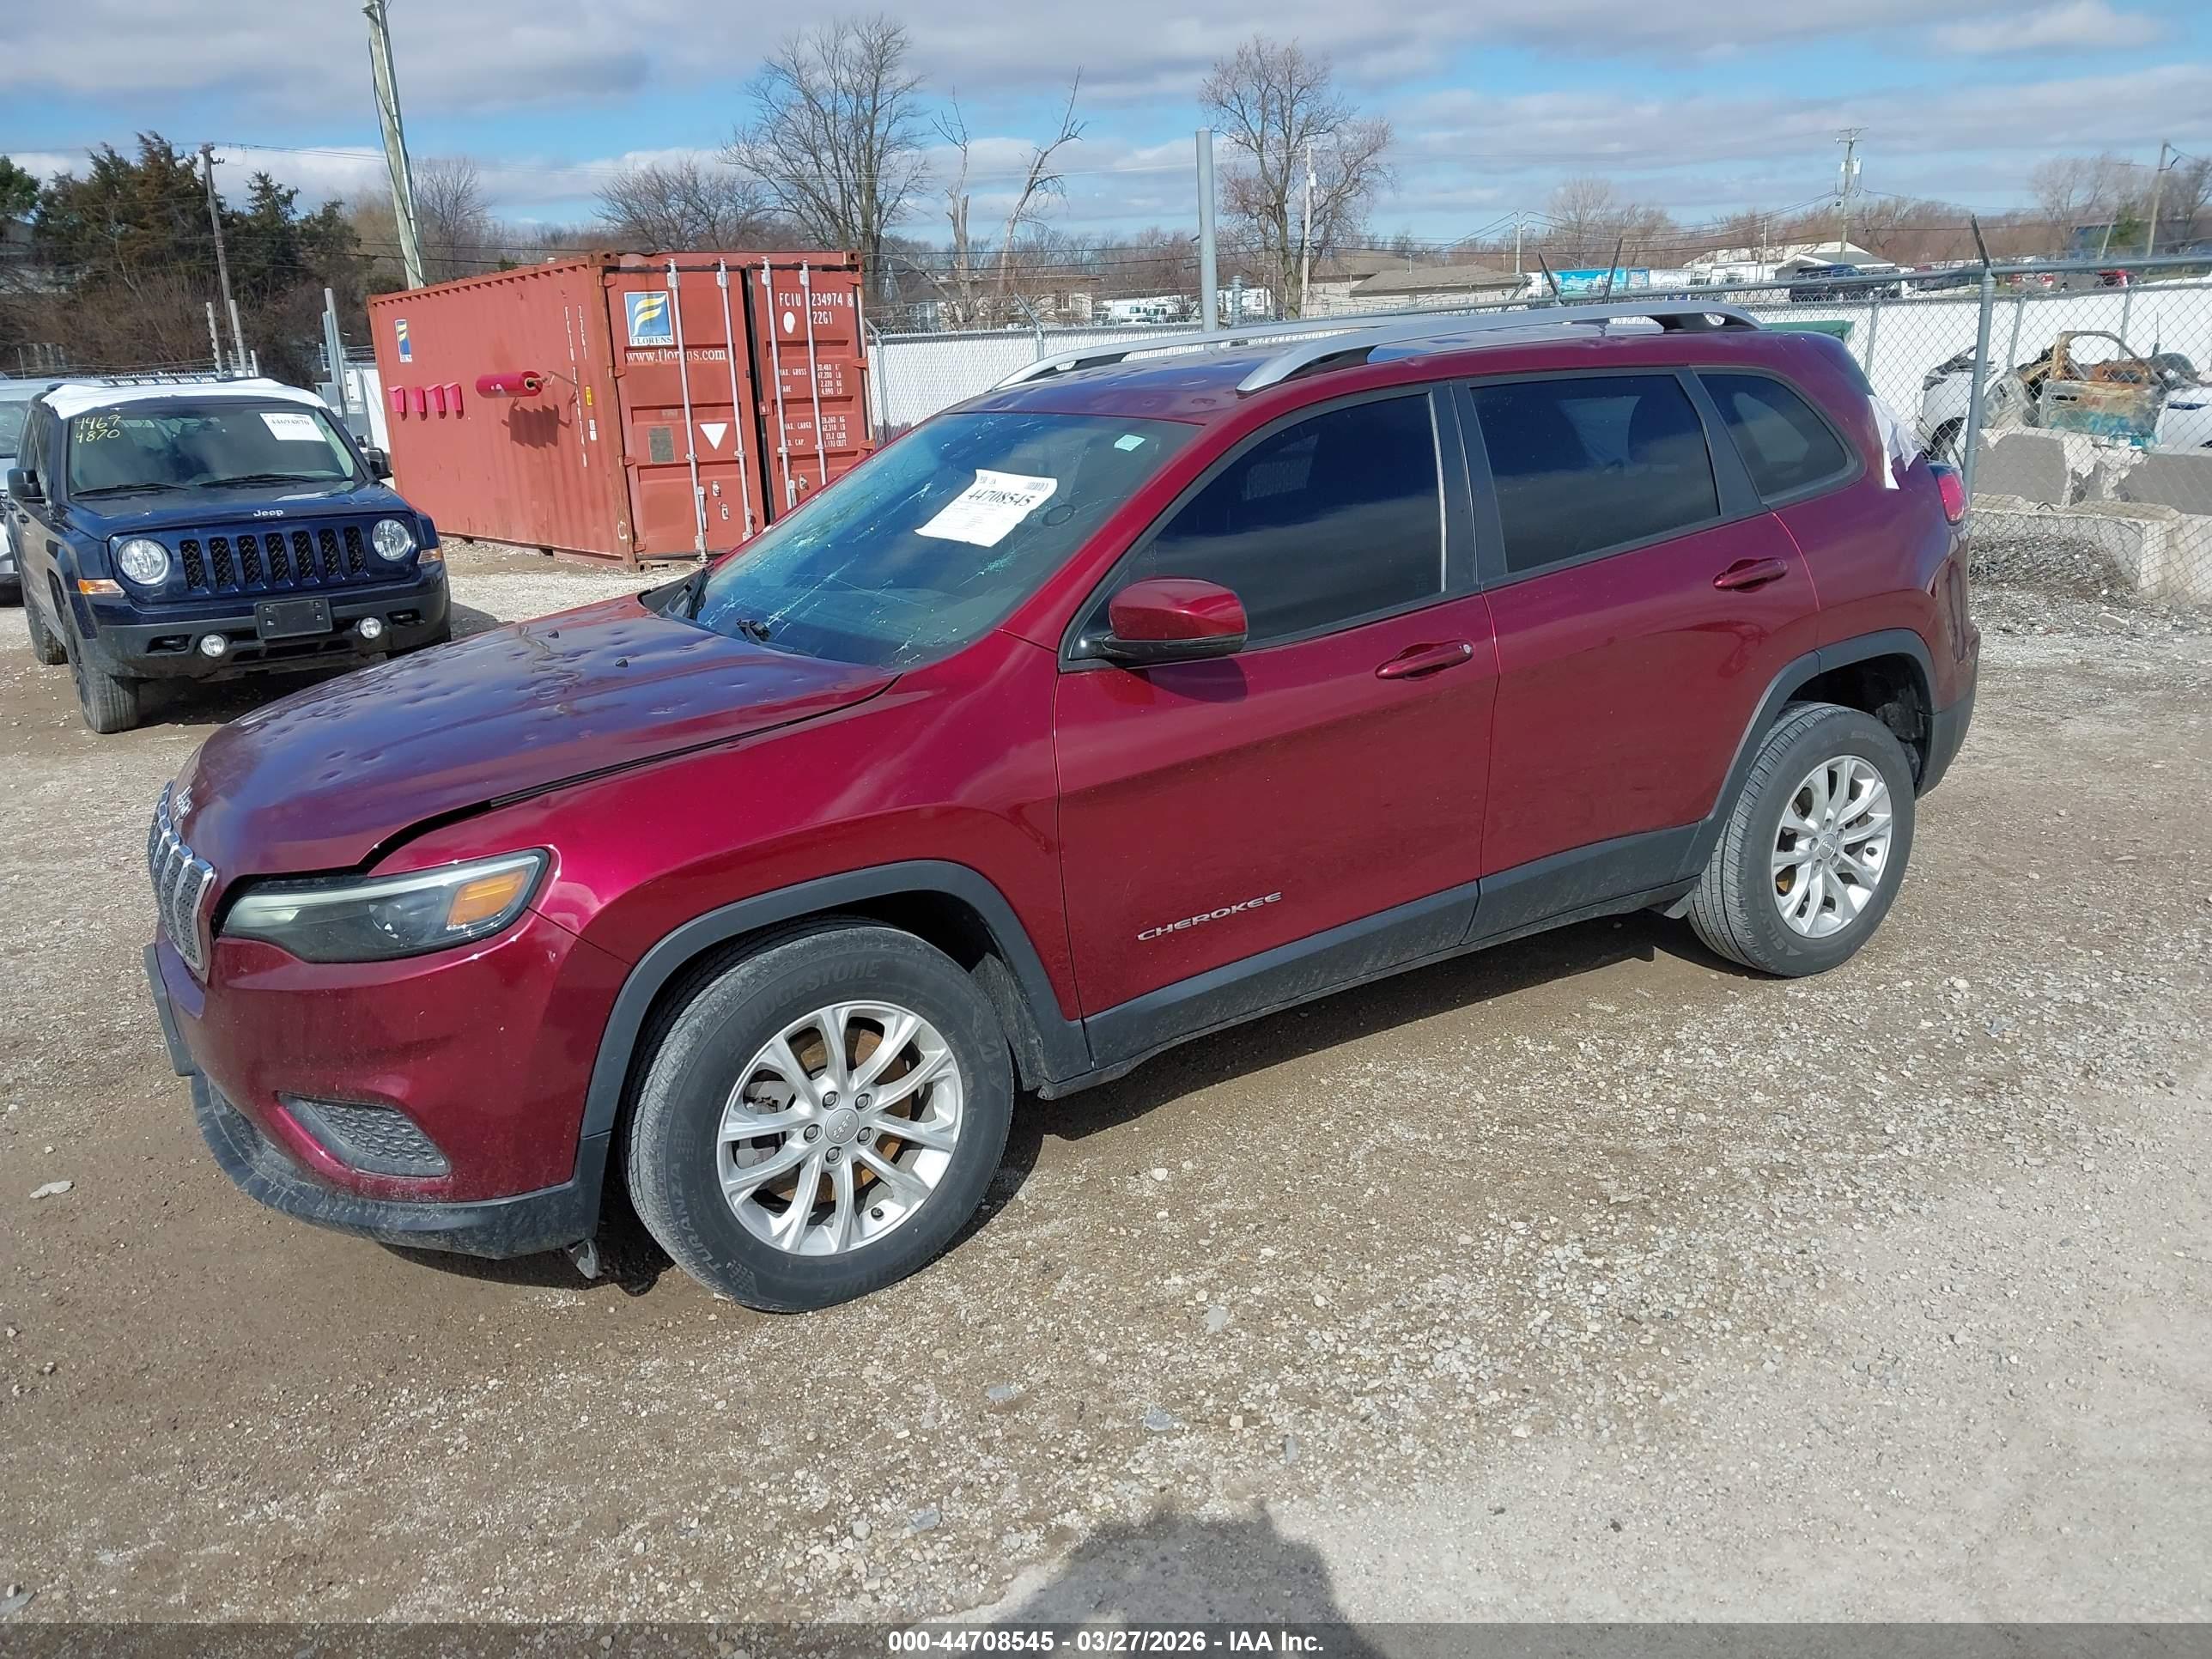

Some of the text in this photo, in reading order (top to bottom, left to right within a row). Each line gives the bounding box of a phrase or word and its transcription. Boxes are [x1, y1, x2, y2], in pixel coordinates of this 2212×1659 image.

[779, 293, 801, 307] FCIU
[811, 293, 843, 306] 234974
[812, 311, 833, 325] 22G1
[631, 336, 672, 344] FLORENS
[625, 348, 726, 362] www.florns.com
[793, 368, 807, 376] GROSS
[75, 414, 121, 429] 4469
[76, 429, 120, 443] 4870
[968, 489, 1036, 506] 44708545
[1138, 891, 1282, 941] CHEROKEE
